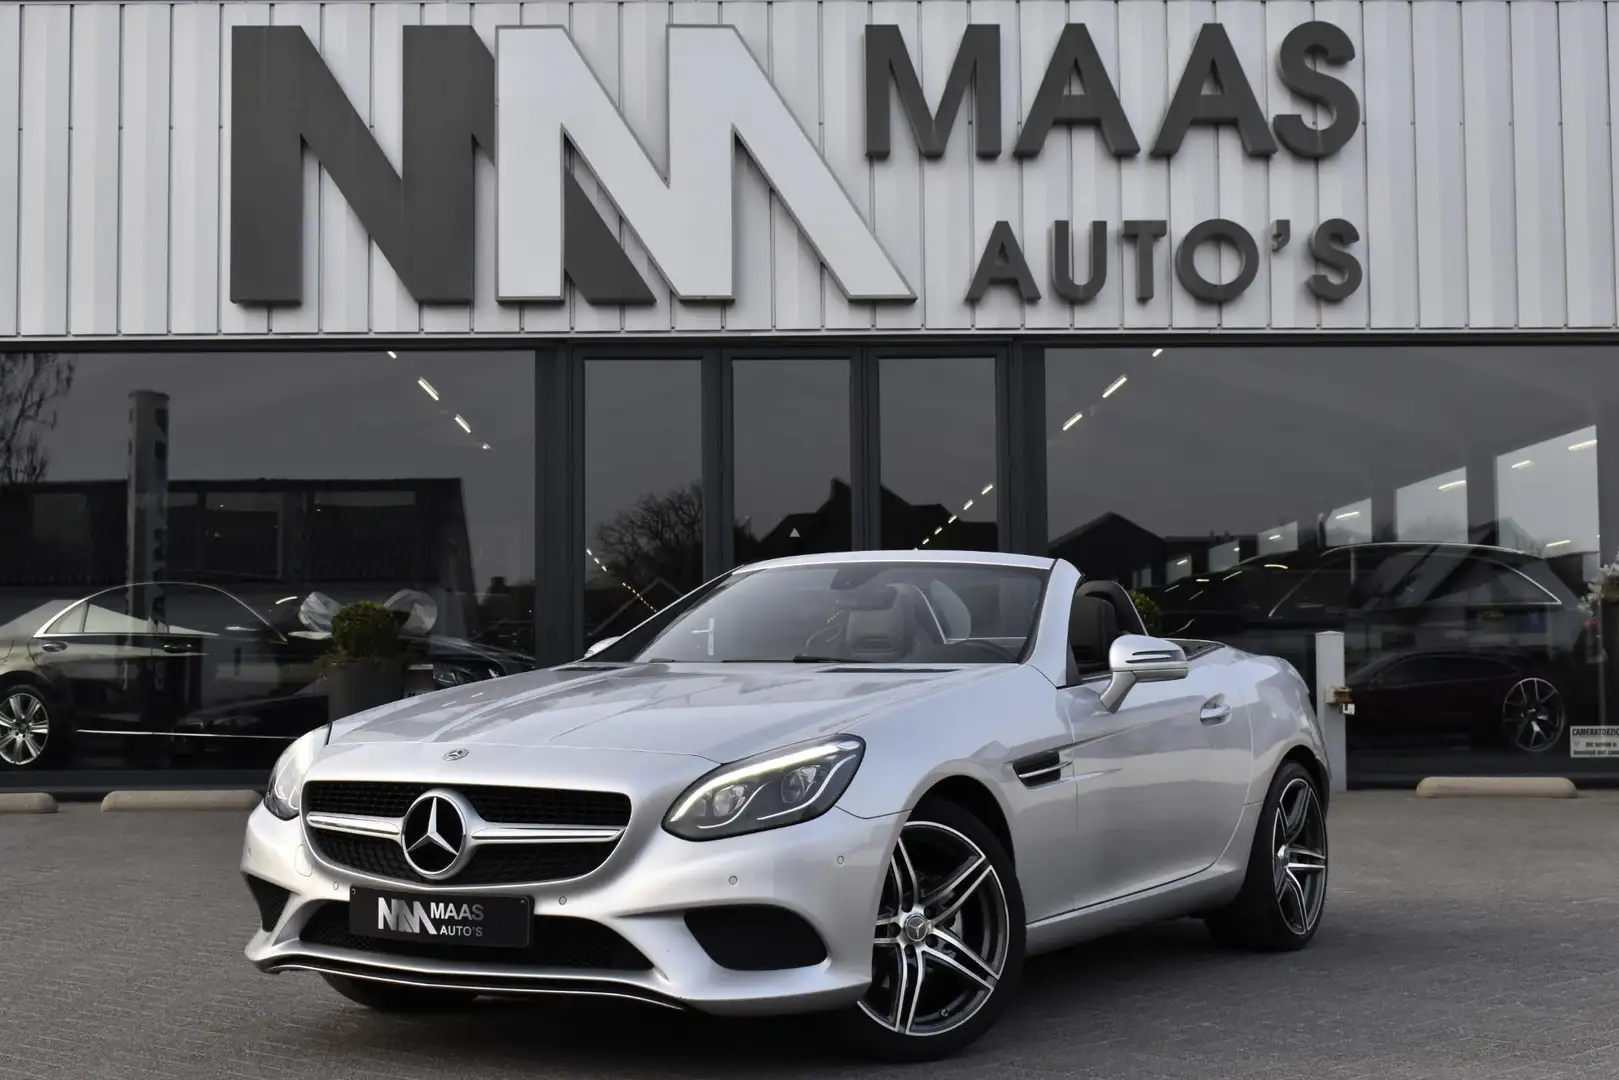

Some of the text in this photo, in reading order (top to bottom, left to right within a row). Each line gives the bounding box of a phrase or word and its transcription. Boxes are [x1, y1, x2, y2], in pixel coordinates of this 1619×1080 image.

[864, 20, 1361, 159] MAAS
[964, 218, 1363, 304] AUTO'S
[430, 902, 484, 921] MAAS
[439, 925, 483, 937] AUTO'S
